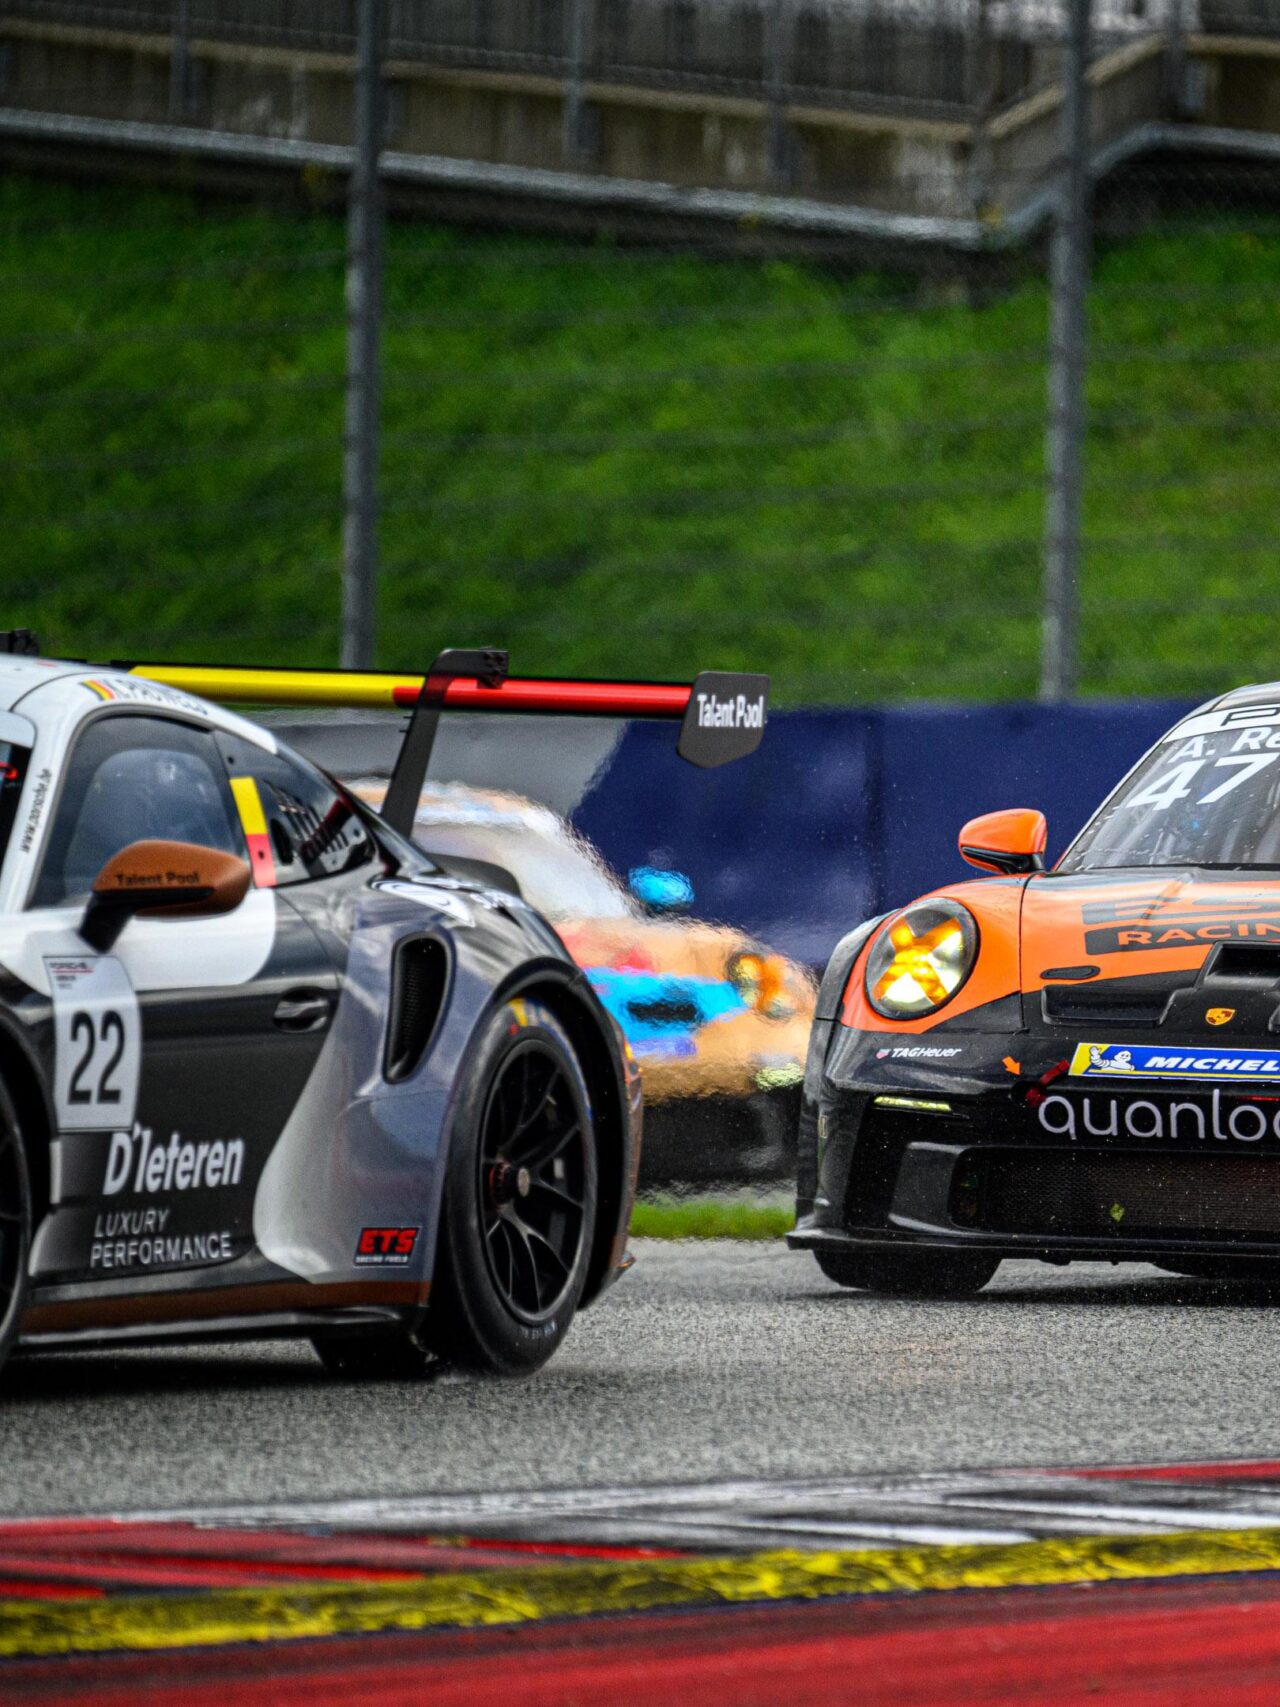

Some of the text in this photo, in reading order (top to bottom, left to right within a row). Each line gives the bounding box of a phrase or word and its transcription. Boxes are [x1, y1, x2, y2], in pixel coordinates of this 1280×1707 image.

[697, 694, 764, 728] Talent Pool
[1168, 735, 1216, 763] A.
[1125, 752, 1280, 811] 47
[67, 1010, 126, 1105] 22
[94, 1206, 169, 1238] LUXURY
[90, 1231, 233, 1268] PERFORMANCE
[359, 1228, 418, 1254] ETS
